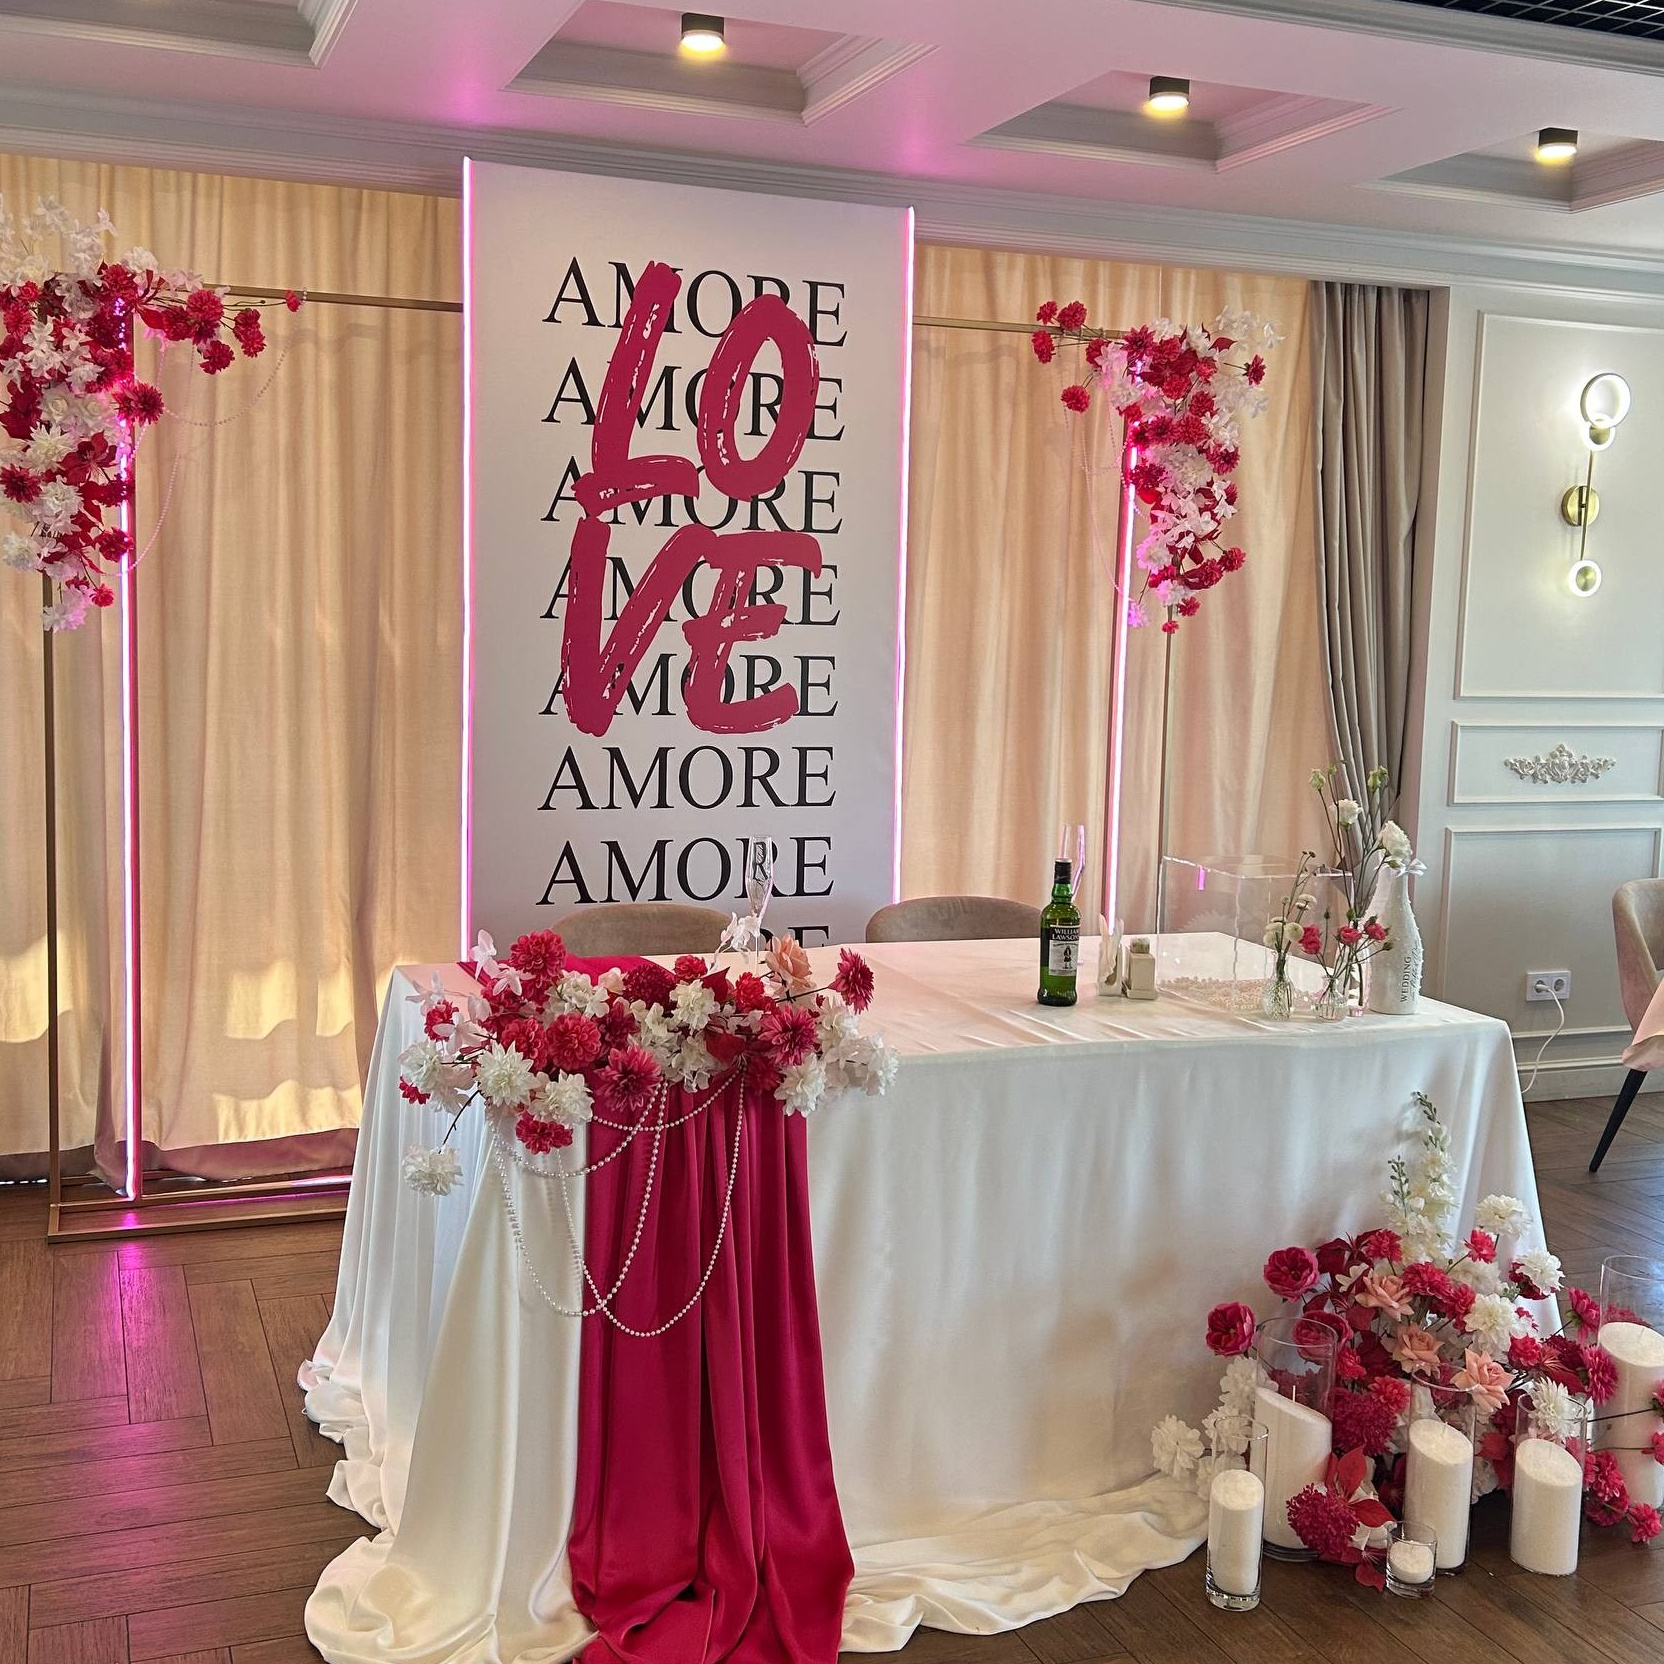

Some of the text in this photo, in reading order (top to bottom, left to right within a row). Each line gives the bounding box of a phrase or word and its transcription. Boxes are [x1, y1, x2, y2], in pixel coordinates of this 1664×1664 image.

[537, 746, 836, 811] AMORE
[535, 836, 834, 905] AMORE
[1401, 956, 1412, 1002] WEDDING
